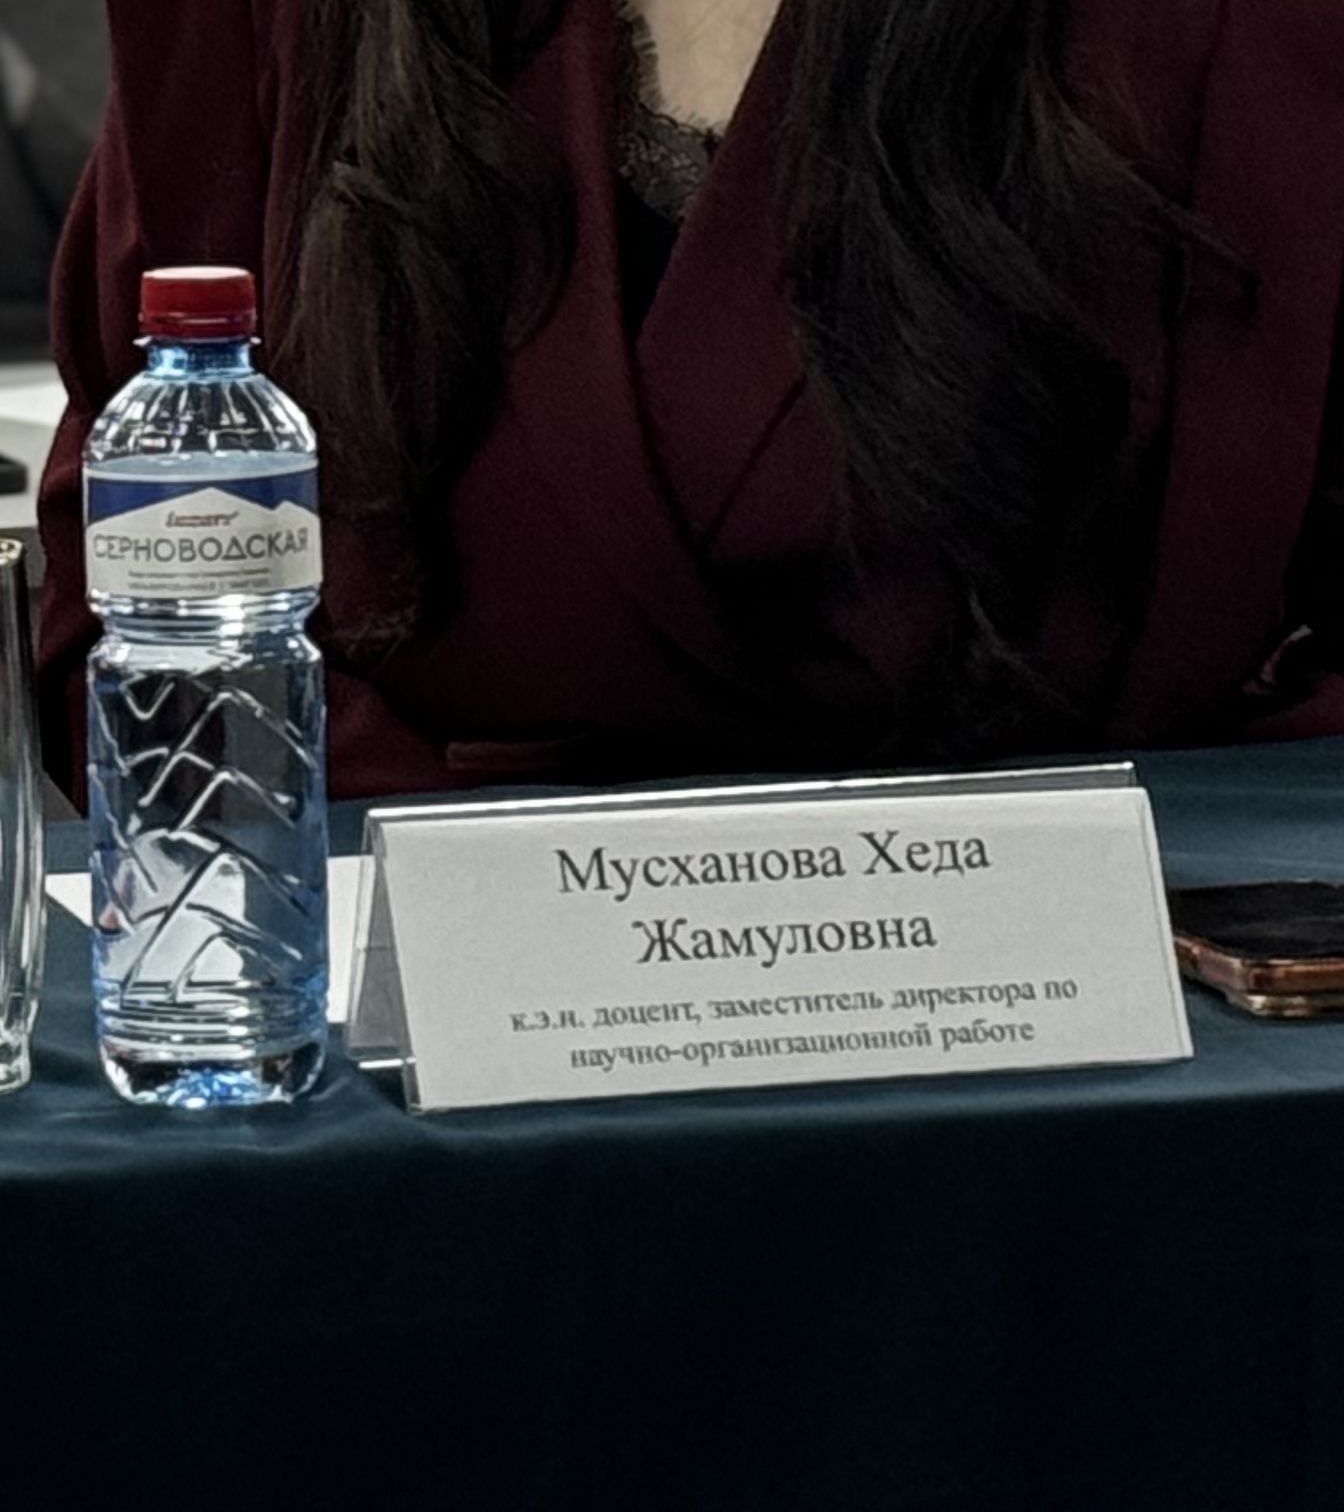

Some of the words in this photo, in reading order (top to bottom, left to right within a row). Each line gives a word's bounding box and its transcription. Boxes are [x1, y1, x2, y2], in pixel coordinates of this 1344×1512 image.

[93, 527, 309, 563] СЕРНОВОДСКАЯ
[555, 843, 847, 902] Мусханова
[858, 829, 991, 877] Хеда
[631, 914, 937, 968] Жамуловна
[592, 1000, 702, 1029] доцент,
[708, 986, 884, 1020] заместитель
[891, 979, 1036, 1014] директора
[1044, 978, 1078, 1000] по
[570, 1021, 932, 1073] научно-организационной
[939, 1017, 1035, 1052] работе
